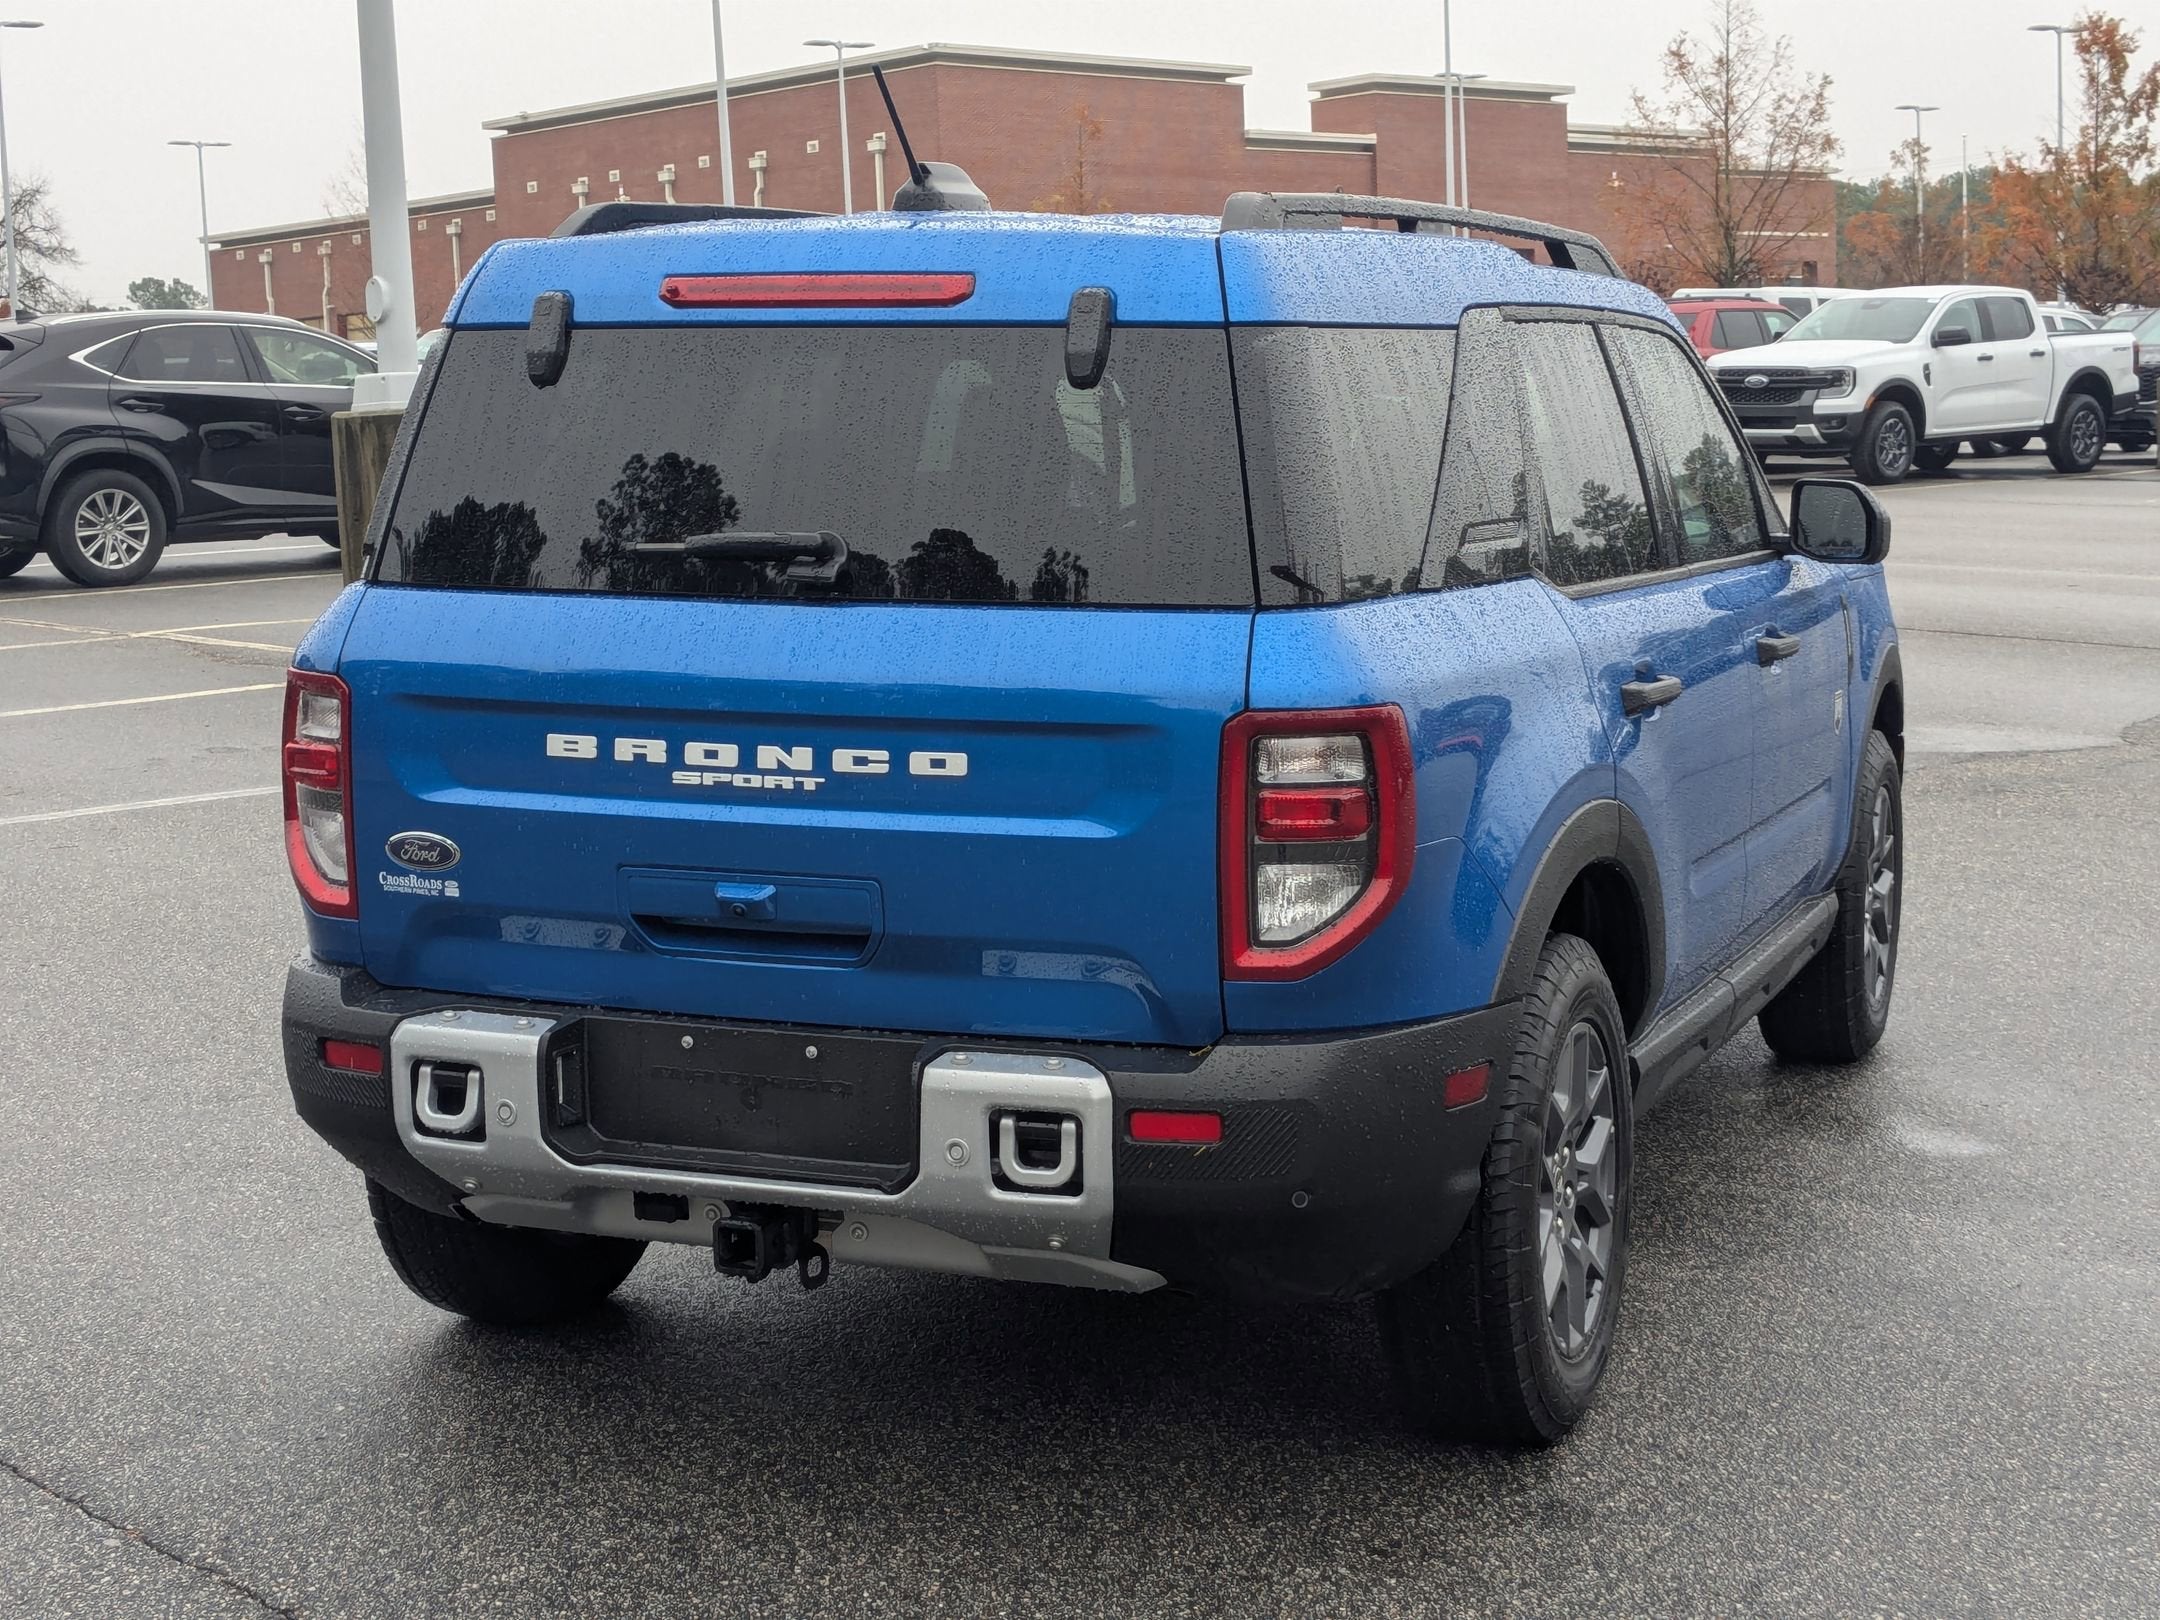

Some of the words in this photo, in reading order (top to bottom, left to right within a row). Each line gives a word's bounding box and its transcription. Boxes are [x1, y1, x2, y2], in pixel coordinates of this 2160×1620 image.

[546, 733, 968, 776] BRONCO
[672, 771, 825, 791] SPORT
[400, 839, 440, 862] Ford
